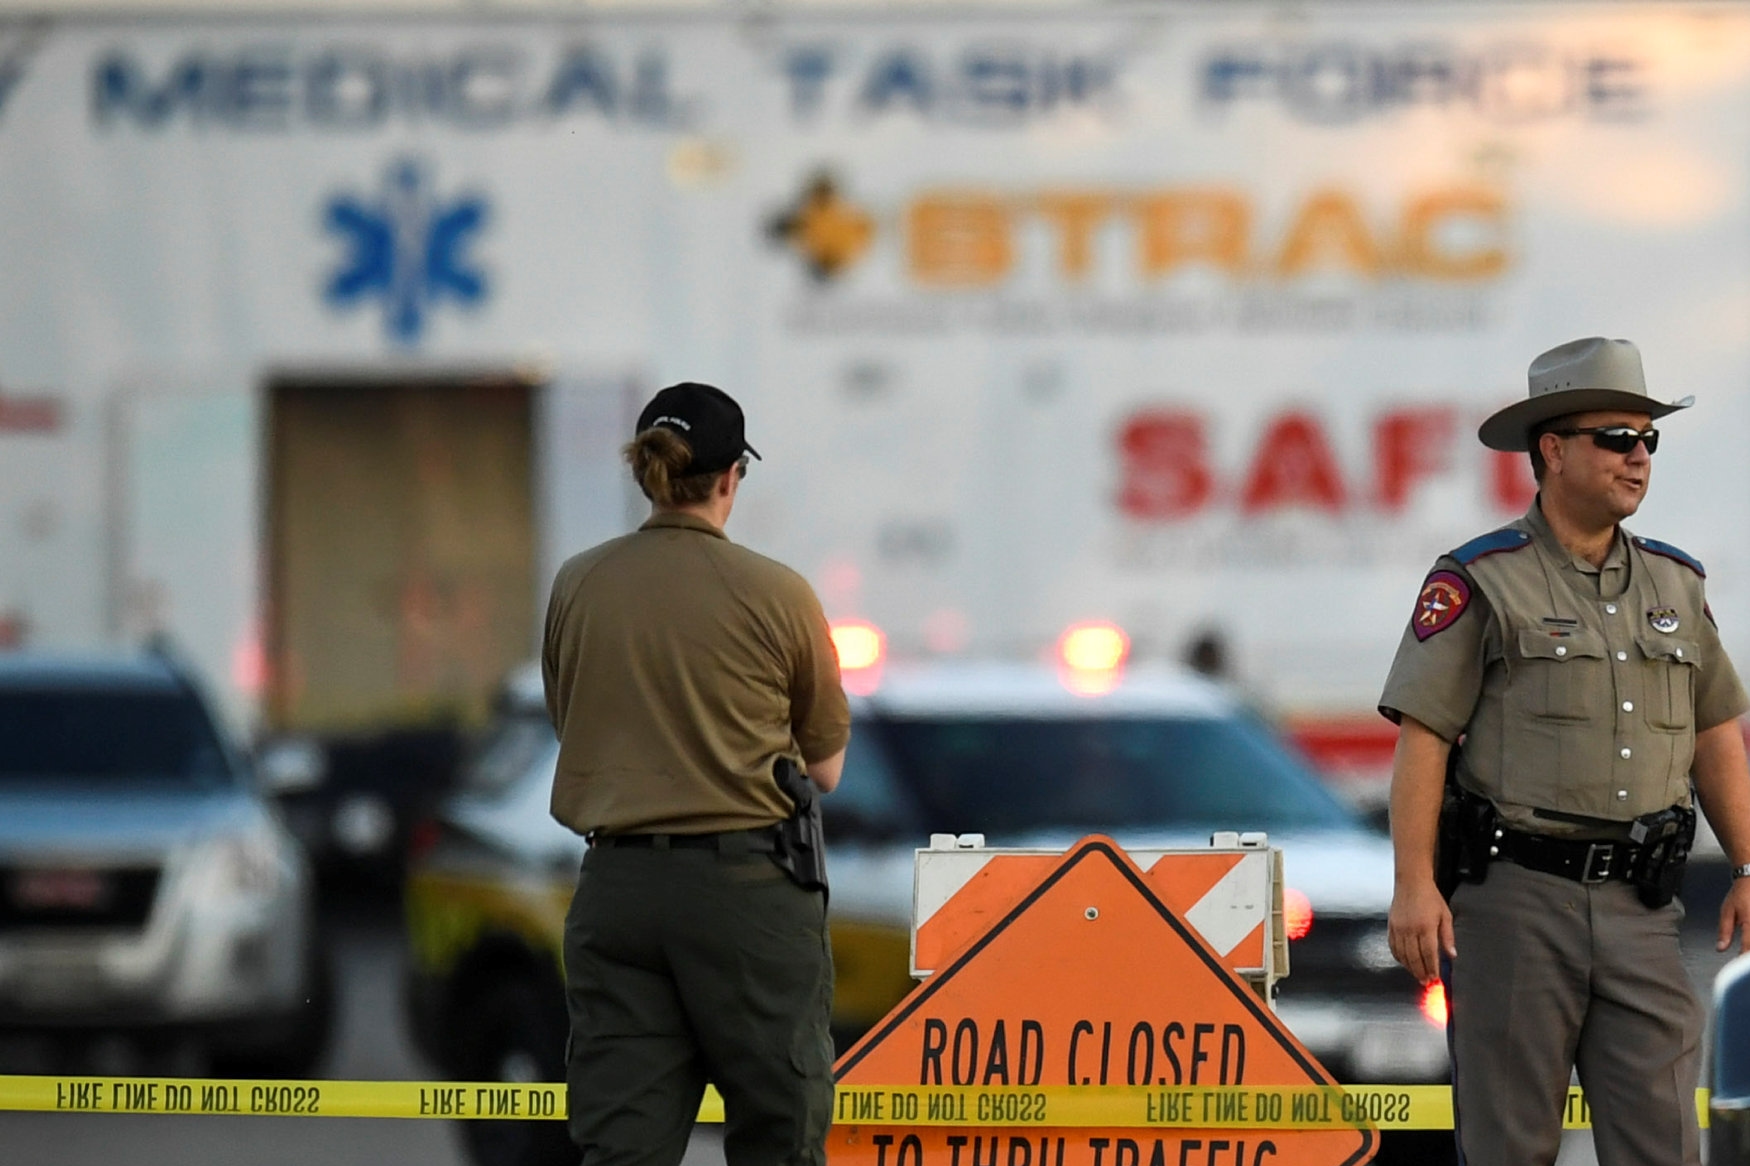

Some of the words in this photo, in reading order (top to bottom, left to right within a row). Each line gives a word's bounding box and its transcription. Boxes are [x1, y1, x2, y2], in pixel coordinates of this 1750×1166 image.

[92, 46, 692, 134] MEDICAL
[785, 44, 1114, 124] TASK
[1197, 44, 1656, 128] FORCE
[920, 1018, 1044, 1086] ROAD
[1067, 1019, 1246, 1086] CLOSED
